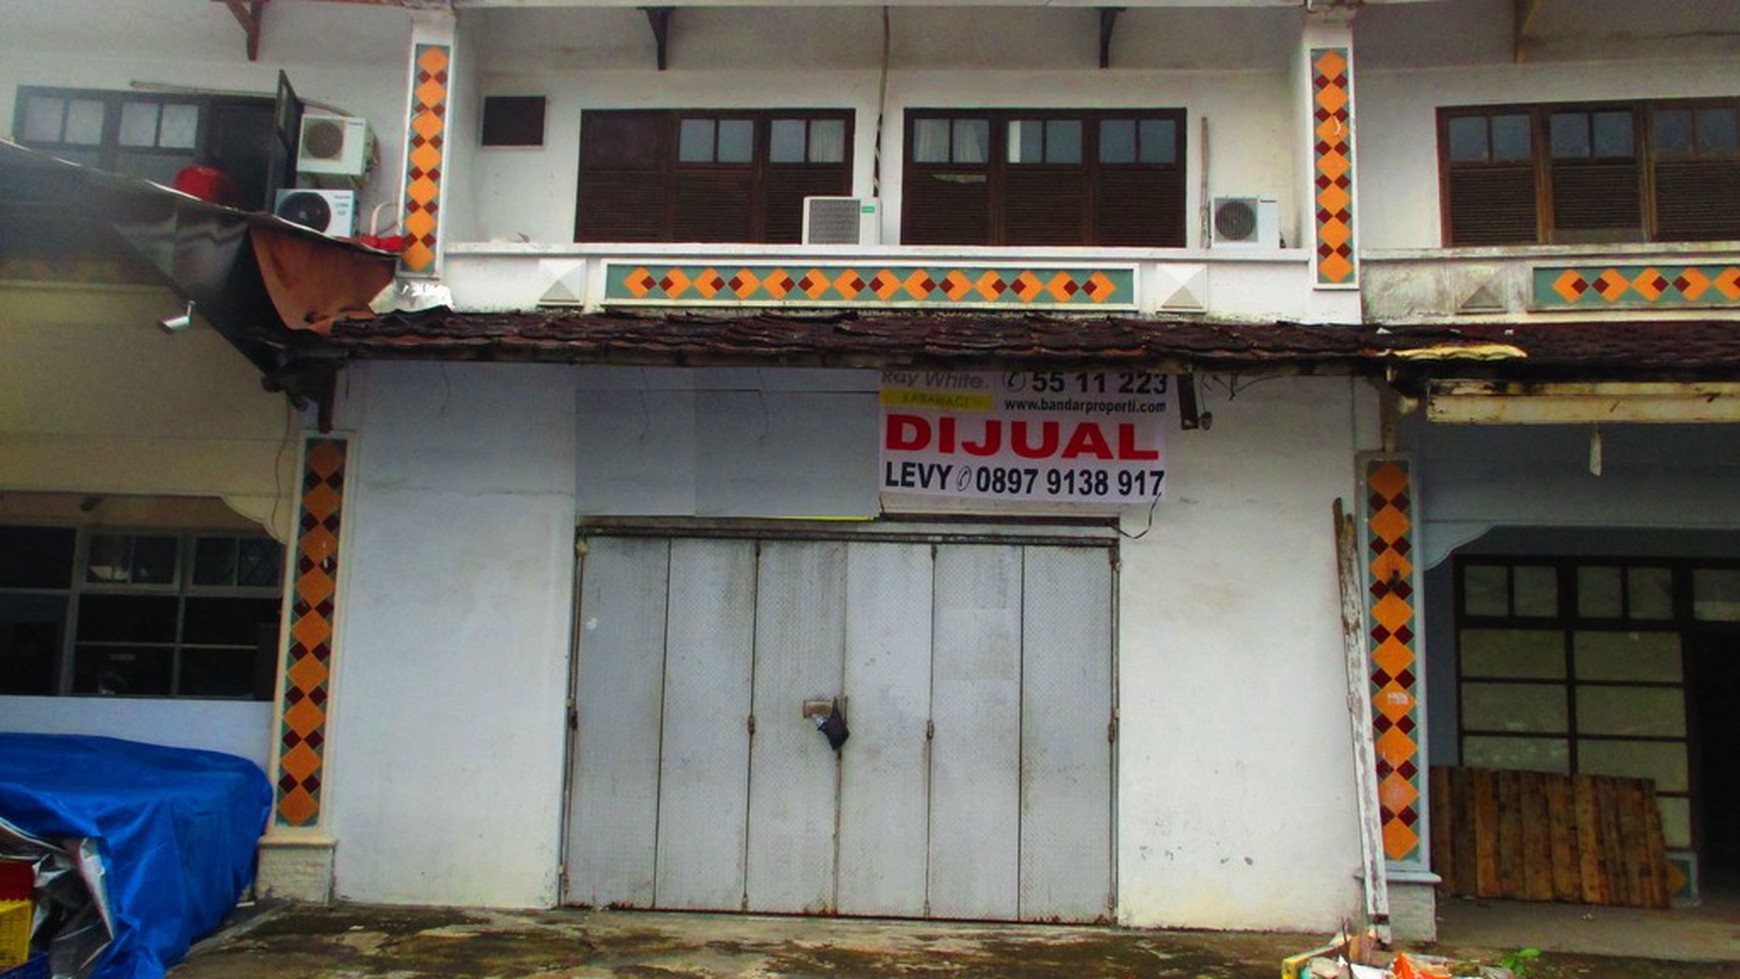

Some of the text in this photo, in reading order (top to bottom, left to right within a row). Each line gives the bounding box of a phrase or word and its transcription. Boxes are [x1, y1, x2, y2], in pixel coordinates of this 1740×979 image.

[881, 368, 918, 387] Ray
[1032, 371, 1168, 394] 55 11 223
[1005, 399, 1167, 414] www.bandarproperti.com
[886, 414, 1159, 460] DIJUAL
[885, 461, 1165, 496] LEVY 0897 9138 917
